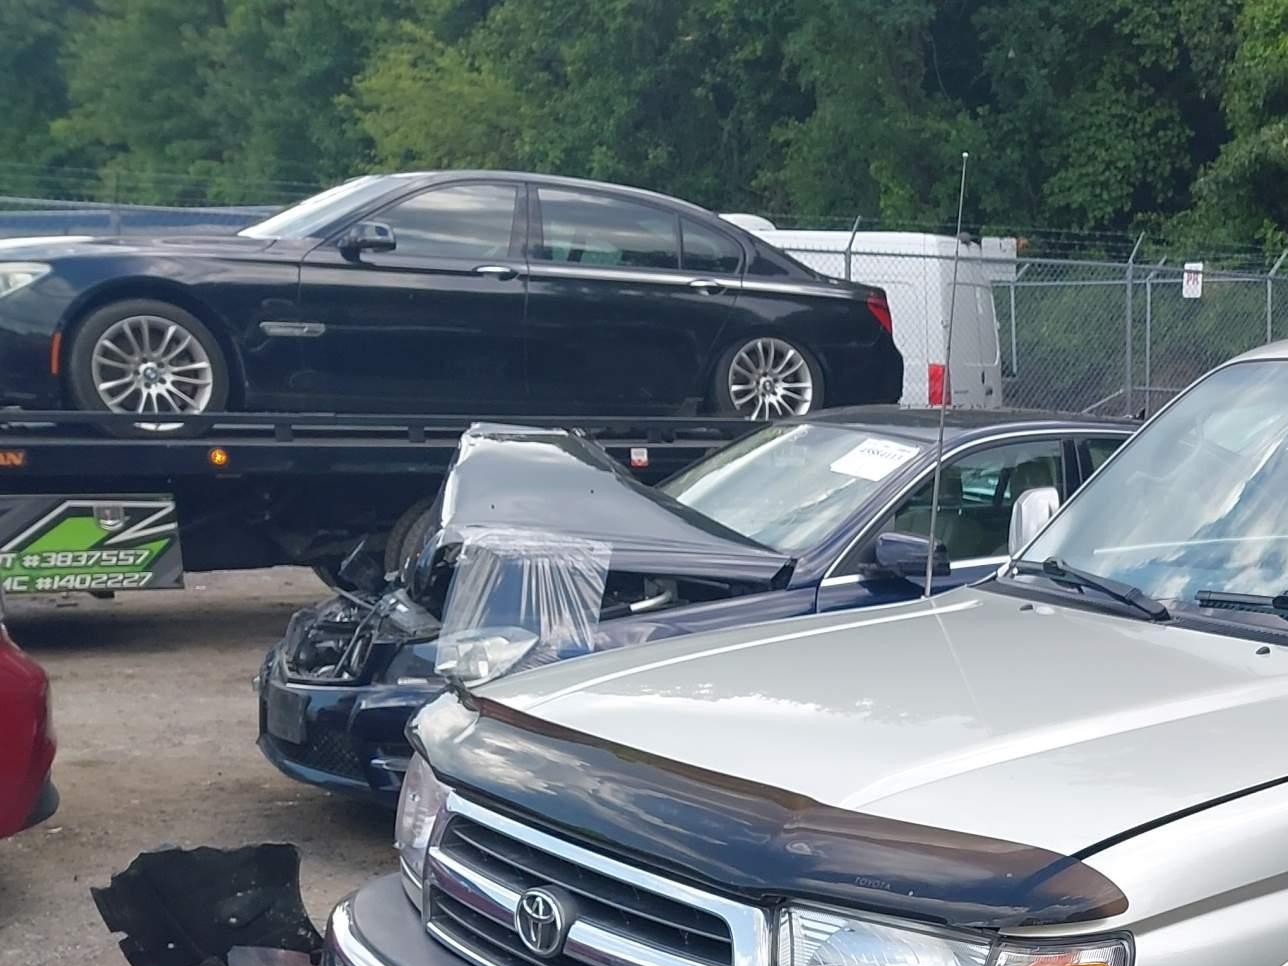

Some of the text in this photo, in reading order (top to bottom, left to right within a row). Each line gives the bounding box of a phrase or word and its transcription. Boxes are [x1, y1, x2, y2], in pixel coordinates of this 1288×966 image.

[22, 550, 150, 568] #3837557
[35, 572, 153, 590] #1402227
[854, 876, 891, 890] TOYOTA
